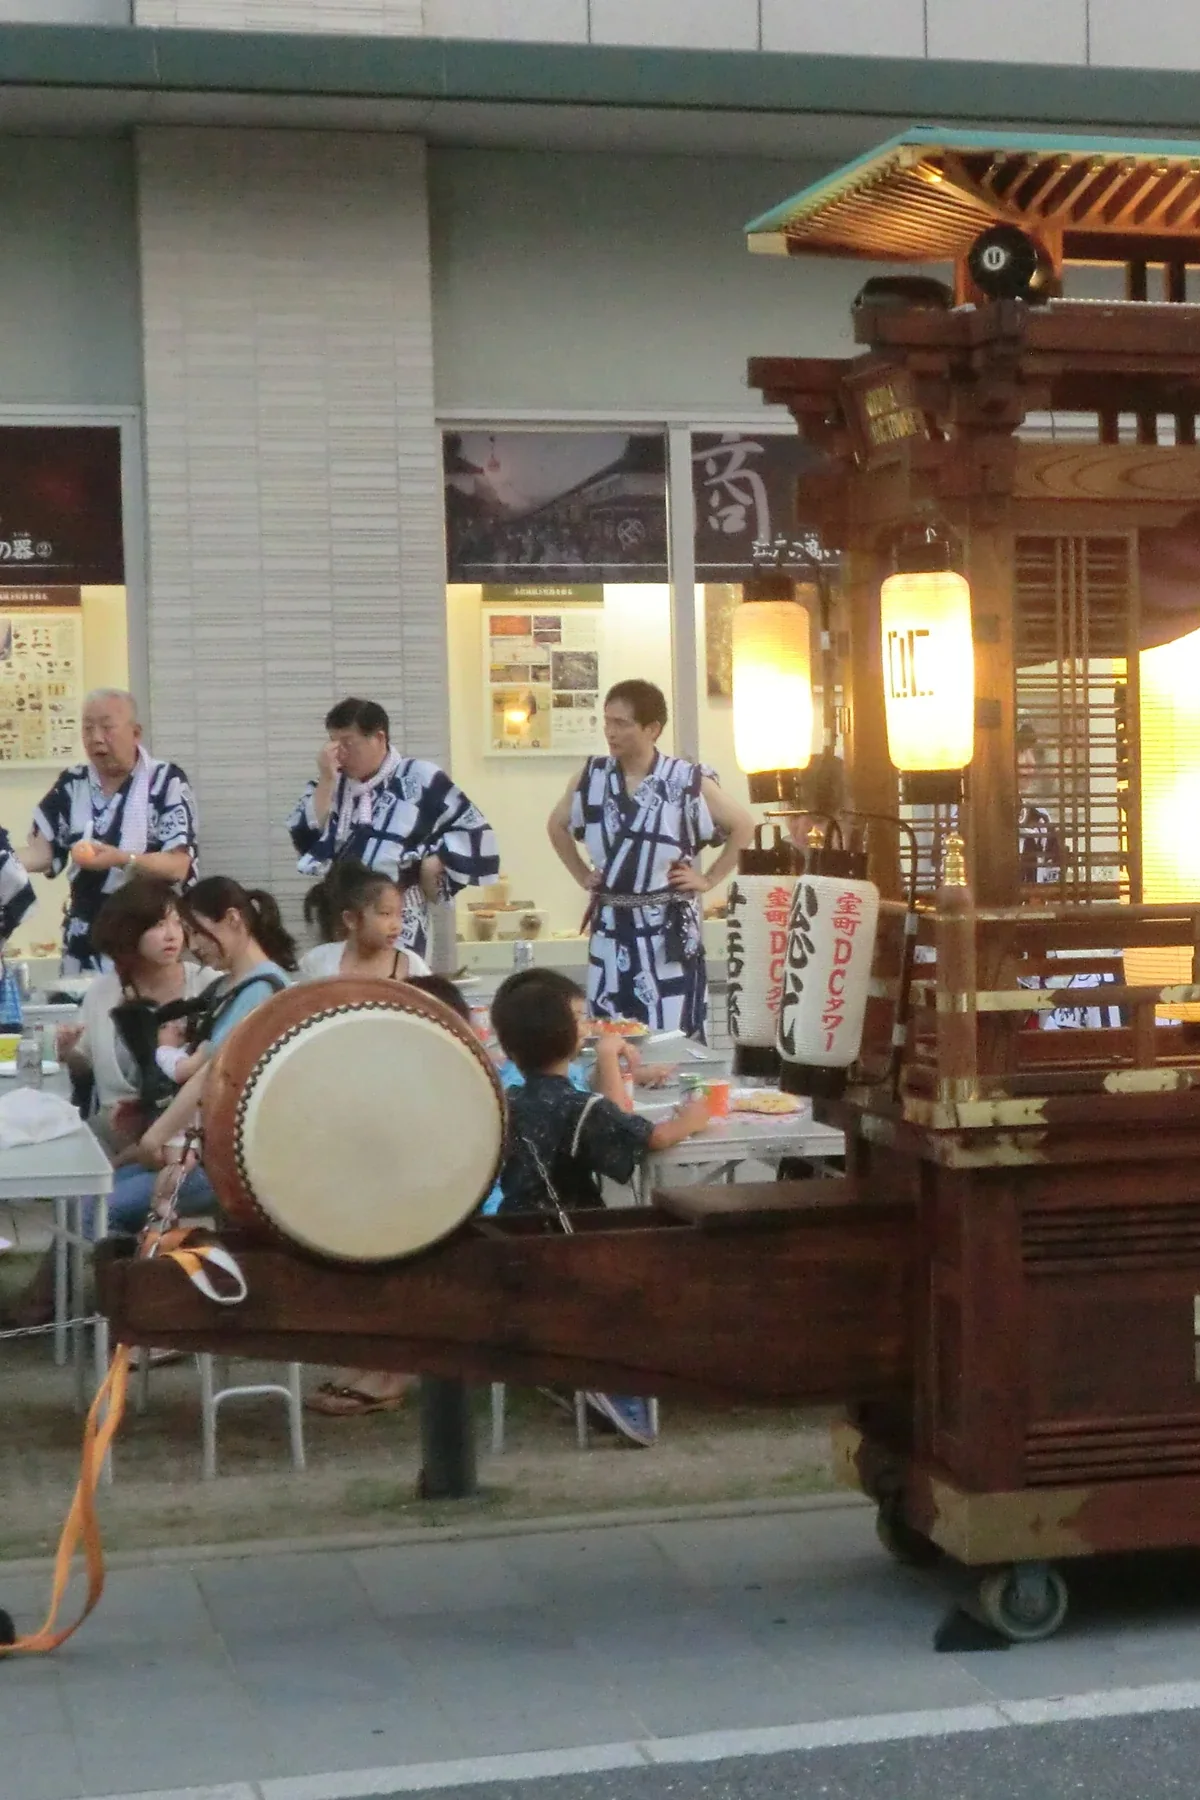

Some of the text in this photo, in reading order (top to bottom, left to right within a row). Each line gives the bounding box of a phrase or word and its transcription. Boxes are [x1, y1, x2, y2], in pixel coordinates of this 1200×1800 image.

[764, 887, 791, 1016] 室町DCタワ
[822, 892, 862, 1051] 室町DCタワー
